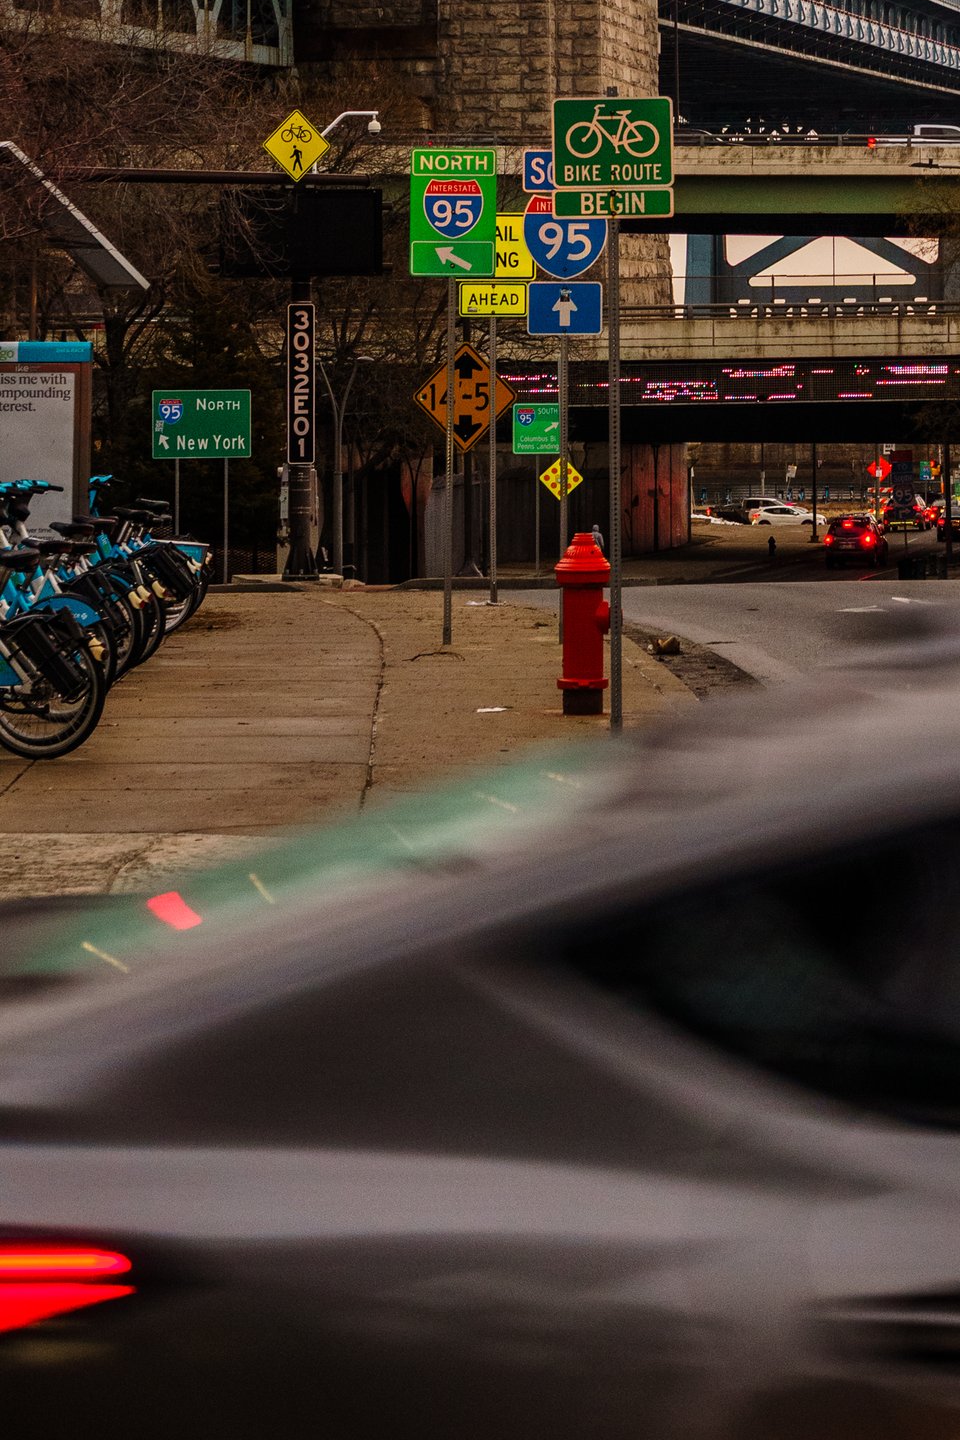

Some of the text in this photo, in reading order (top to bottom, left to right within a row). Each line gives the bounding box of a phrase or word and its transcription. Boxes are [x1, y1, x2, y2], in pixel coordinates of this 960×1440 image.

[419, 154, 488, 171] NORTH
[564, 163, 662, 182] BIKE ROUTE
[430, 184, 477, 193] INTERSTATE
[580, 192, 646, 215] BEGIN
[432, 199, 474, 228] 95
[538, 222, 592, 261] 95
[468, 293, 519, 306] AHEAD
[19, 375, 38, 385] me
[39, 373, 67, 385] with
[293, 310, 310, 458] 3032E01
[0, 387, 71, 401] mpounding
[196, 398, 240, 411] NORTH
[537, 407, 558, 415] SOUTH
[161, 405, 181, 420] 95
[519, 414, 532, 424] 95
[176, 434, 246, 450] New York
